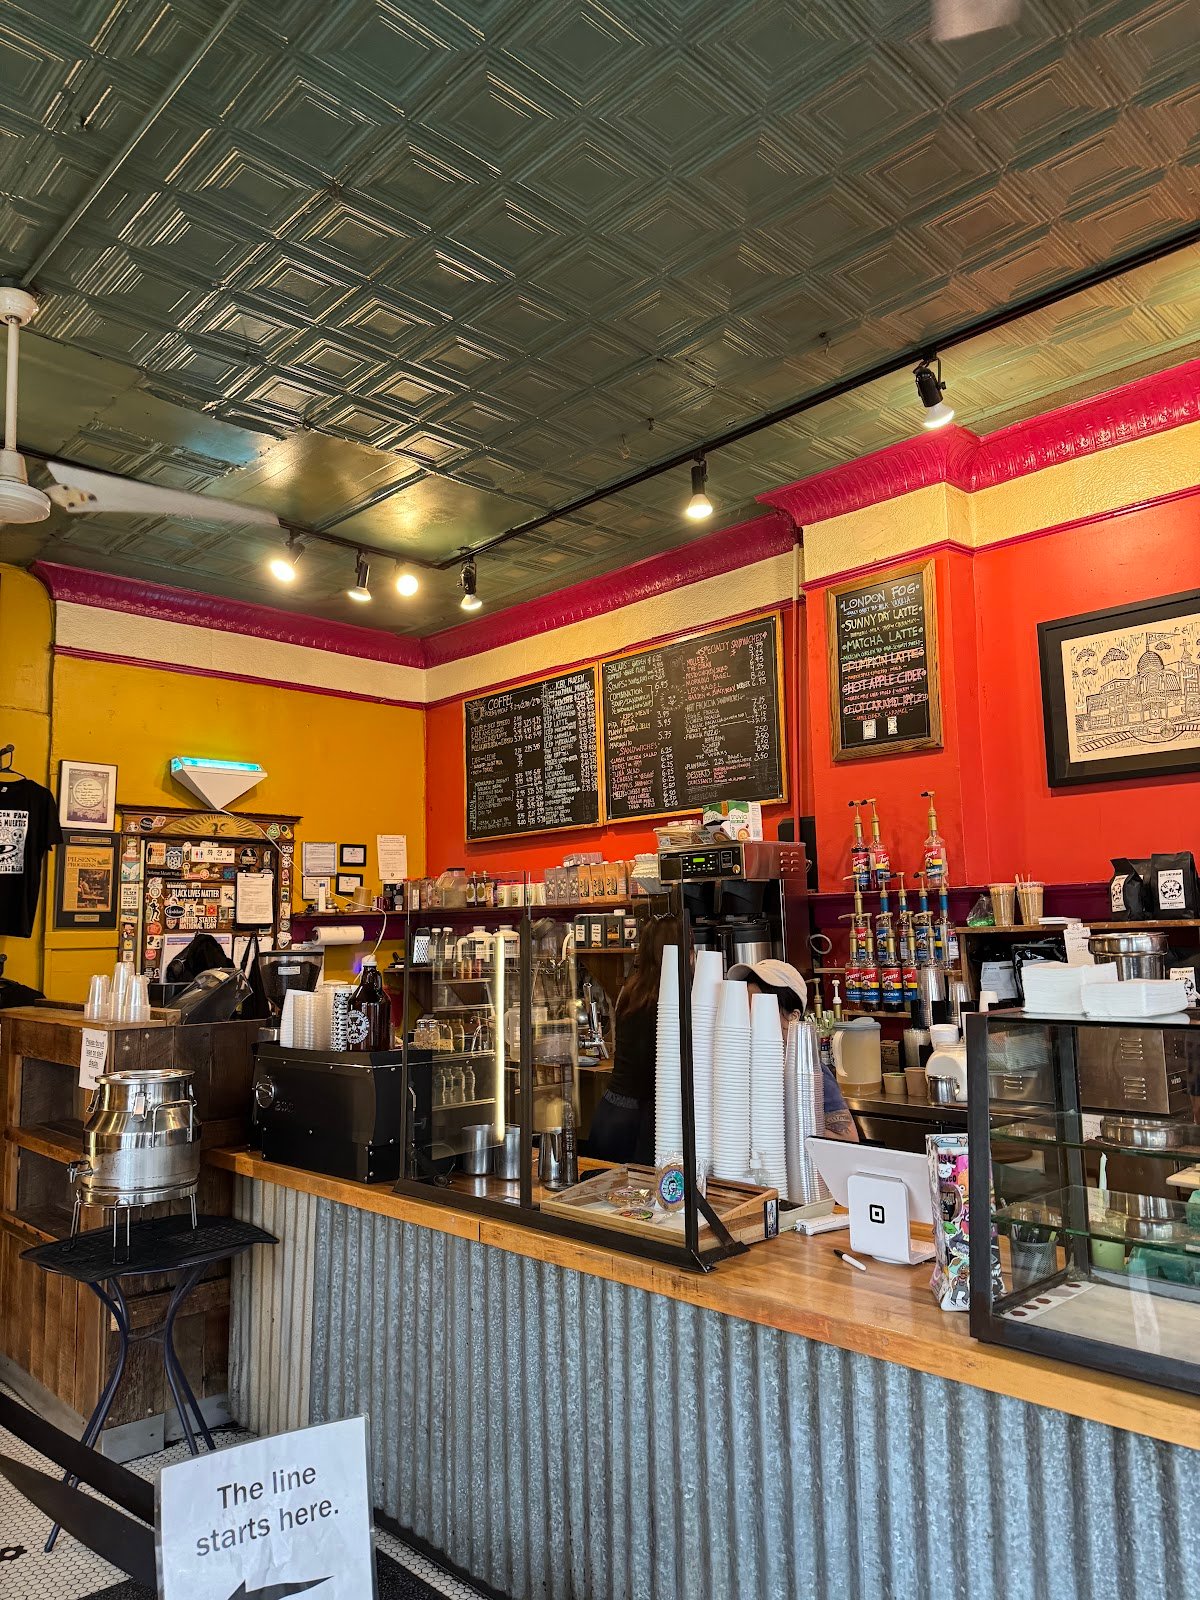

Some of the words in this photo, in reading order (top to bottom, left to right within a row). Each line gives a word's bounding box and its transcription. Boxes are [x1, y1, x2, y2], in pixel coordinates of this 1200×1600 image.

[843, 590, 885, 612] LONDON
[891, 583, 915, 599] FOG
[844, 613, 876, 632] SUNNY
[878, 610, 890, 623] DAY
[893, 604, 919, 620] LATTE
[846, 634, 884, 652] MATCHA
[889, 626, 918, 642] LATTE
[848, 679, 869, 693] HOT
[869, 674, 895, 690] APPLE
[897, 669, 923, 684] CIDER
[488, 694, 512, 711] COFFEE
[554, 718, 568, 728] LATTE
[619, 741, 658, 756] SANDWICHES
[708, 750, 728, 758] WORKS
[172, 889, 187, 898] BLACK
[187, 889, 201, 898] LIVES
[200, 889, 220, 898] MATTER
[179, 922, 203, 930] NATIONAL
[204, 922, 217, 930] TEAM
[882, 971, 899, 981] Torani
[217, 1481, 264, 1509] The
[272, 1467, 316, 1494] line
[196, 1518, 271, 1556] starts
[279, 1499, 339, 1531] here.
